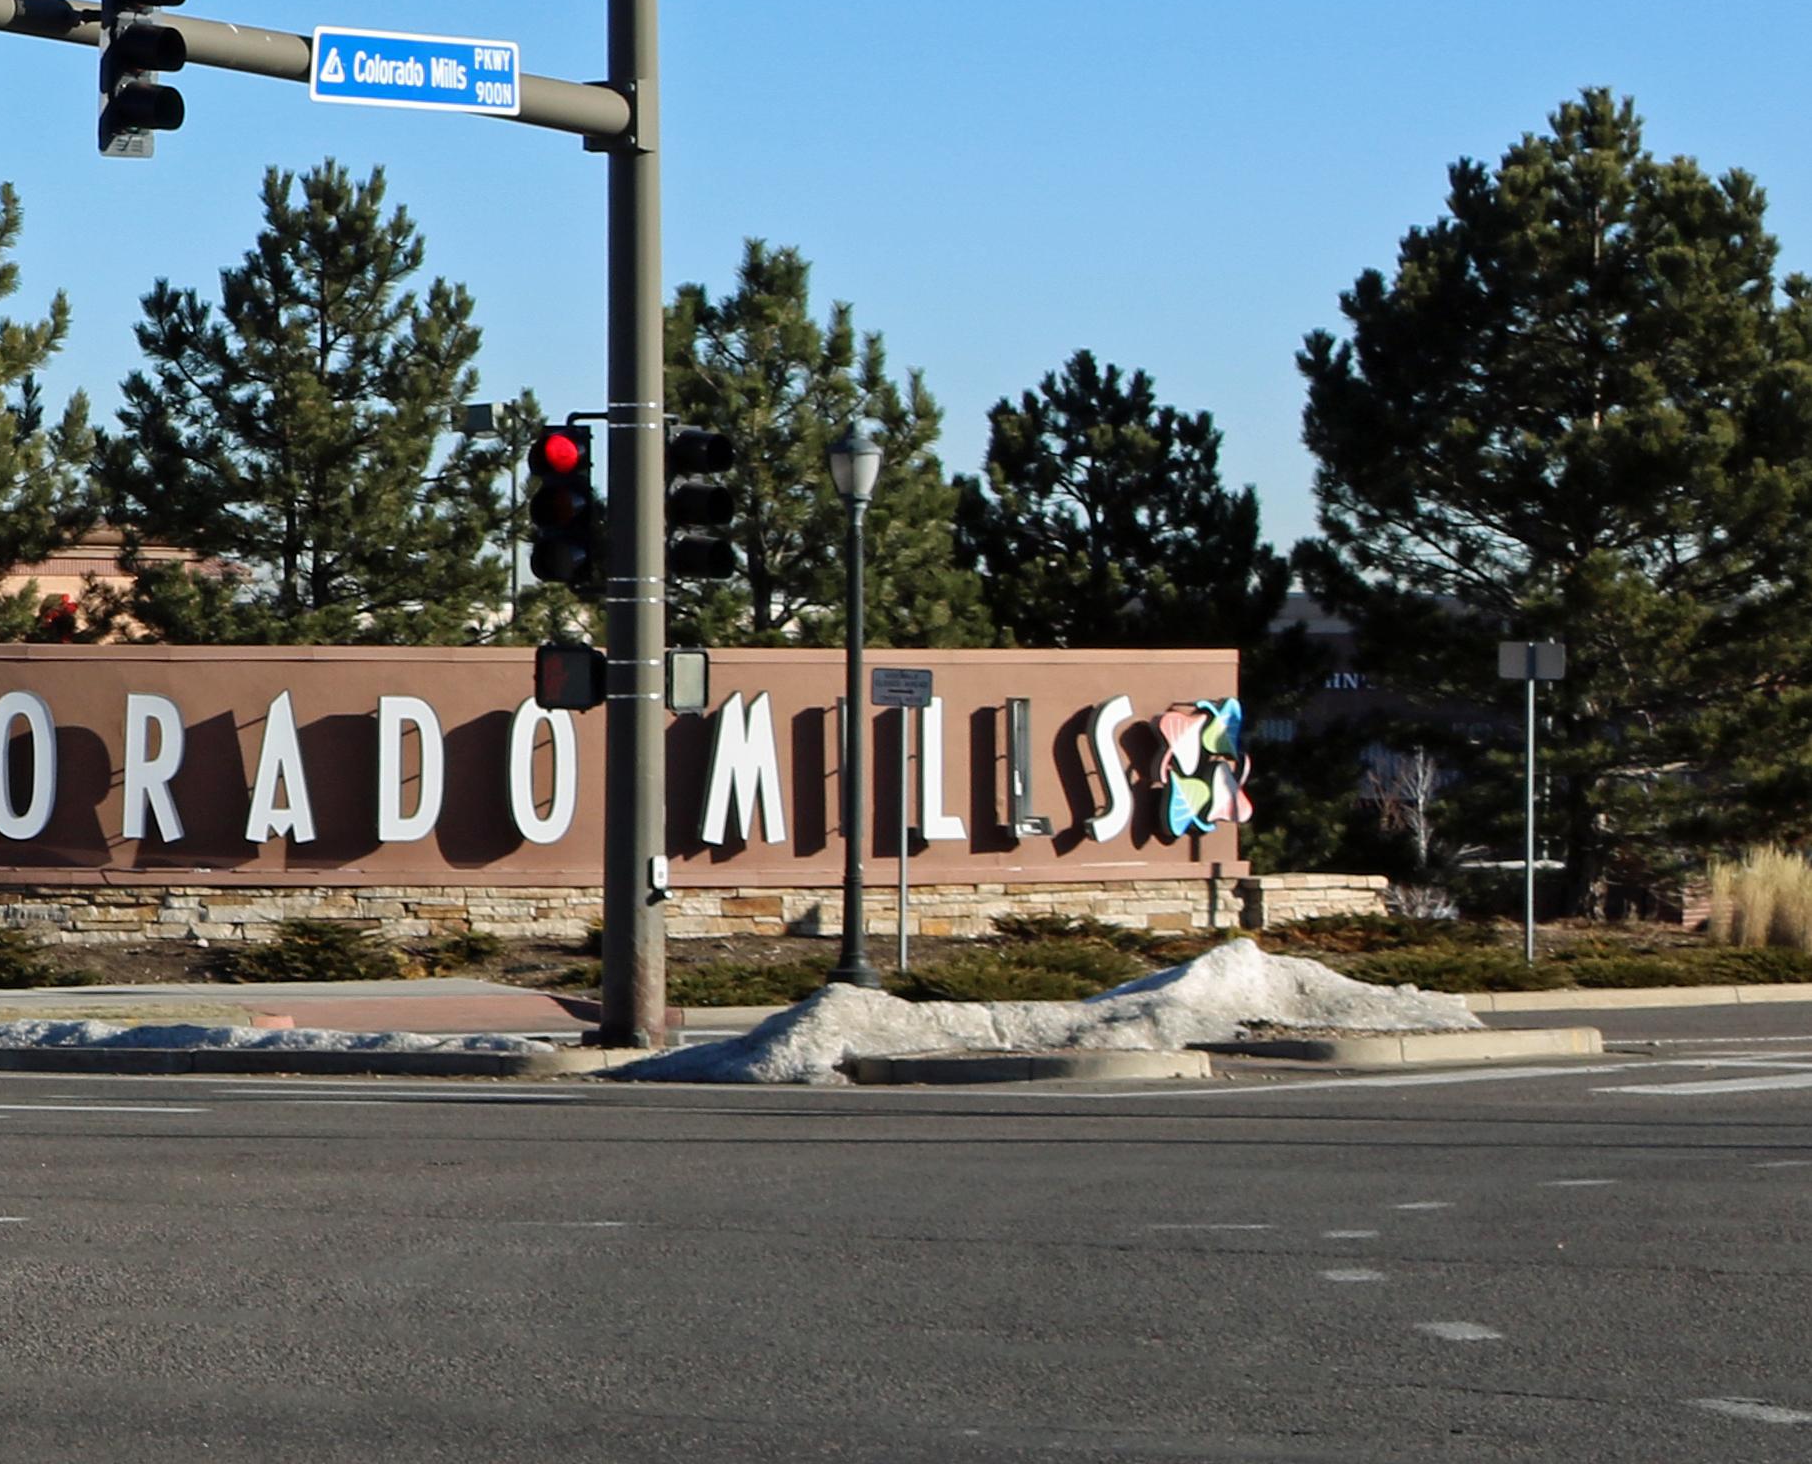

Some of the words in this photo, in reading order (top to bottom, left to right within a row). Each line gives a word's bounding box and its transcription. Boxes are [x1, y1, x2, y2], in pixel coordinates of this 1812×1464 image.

[353, 50, 424, 87] Colorado
[431, 57, 467, 90] Mills
[474, 48, 511, 72] PKWY
